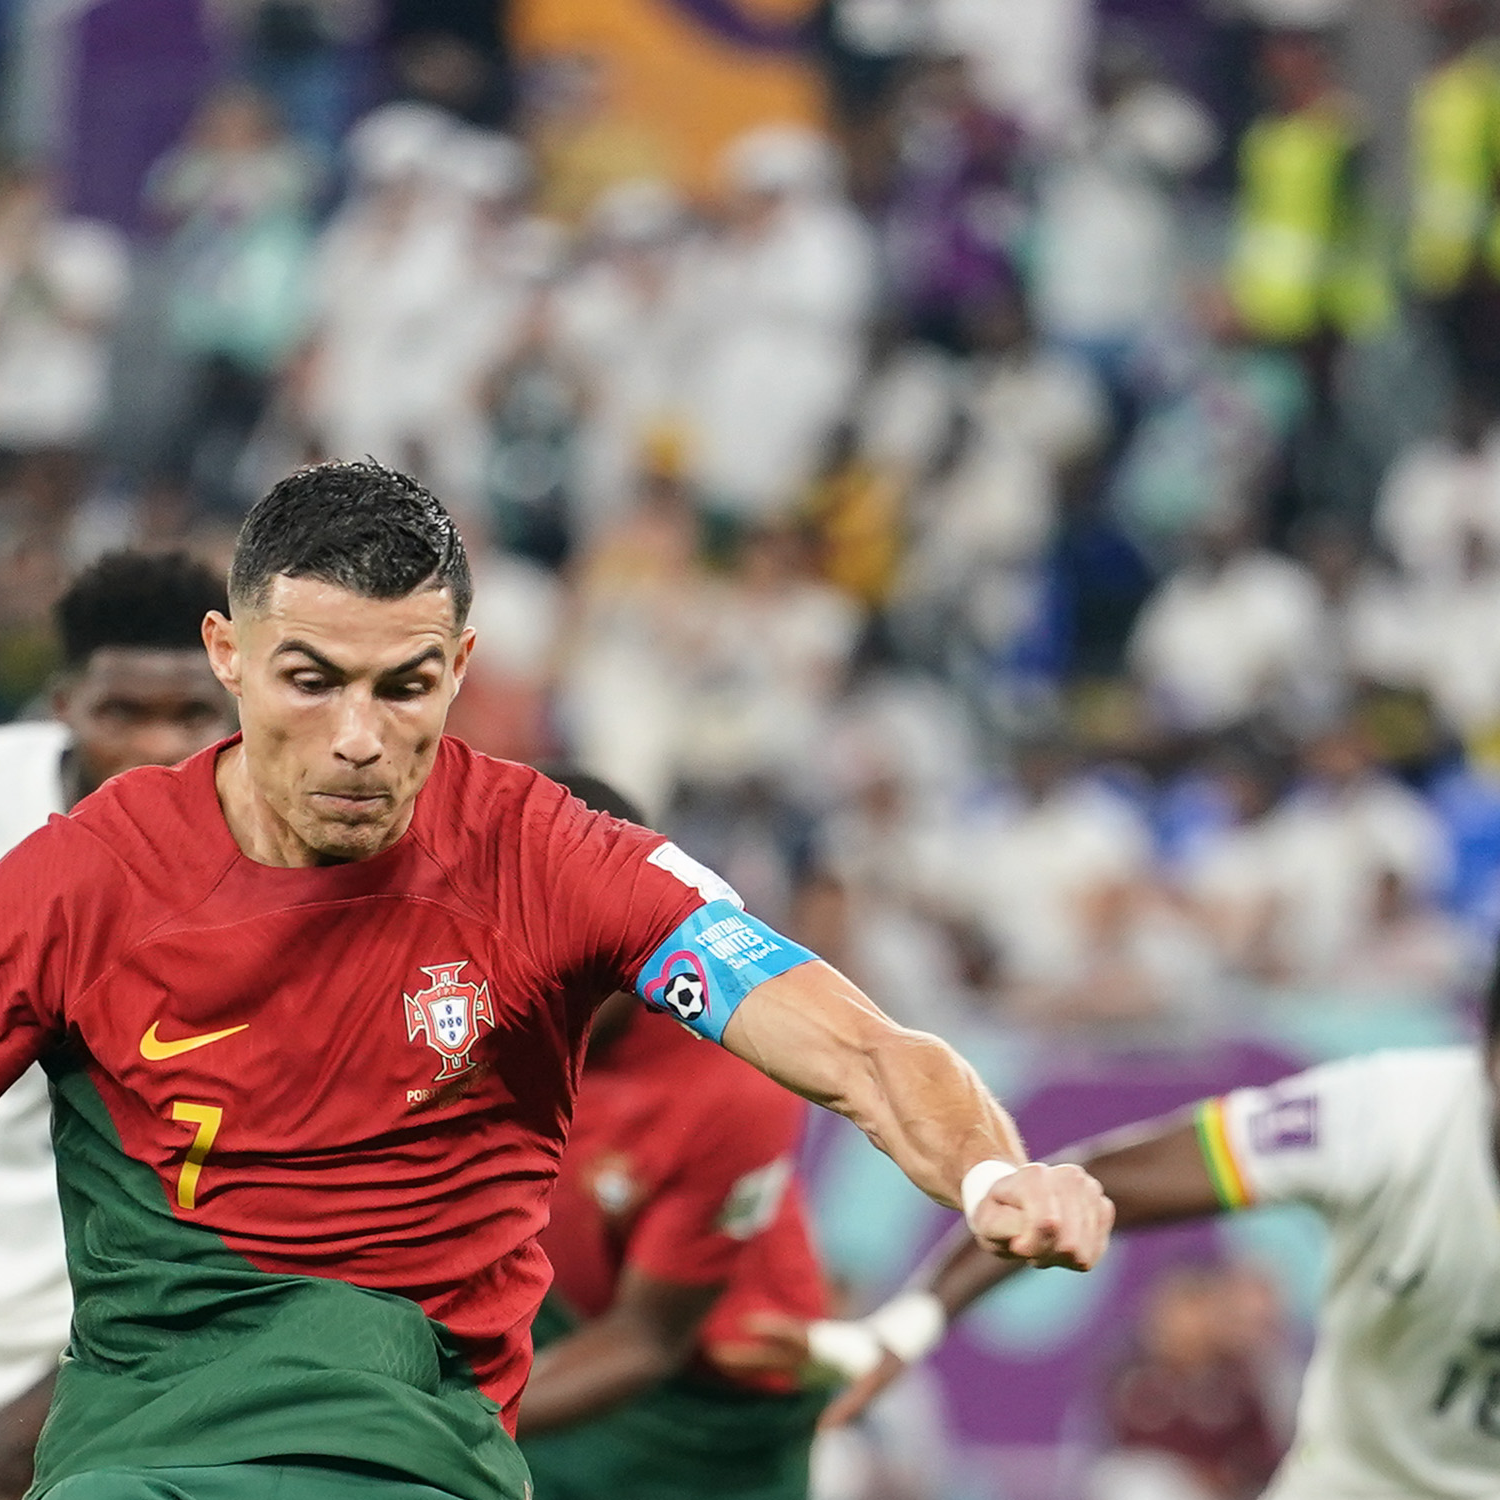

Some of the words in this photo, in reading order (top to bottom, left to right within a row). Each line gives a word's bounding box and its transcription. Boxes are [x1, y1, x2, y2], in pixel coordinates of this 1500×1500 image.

[695, 915, 748, 947] FOOTBALL
[707, 928, 763, 960] UNITES
[172, 1102, 223, 1210] 7
